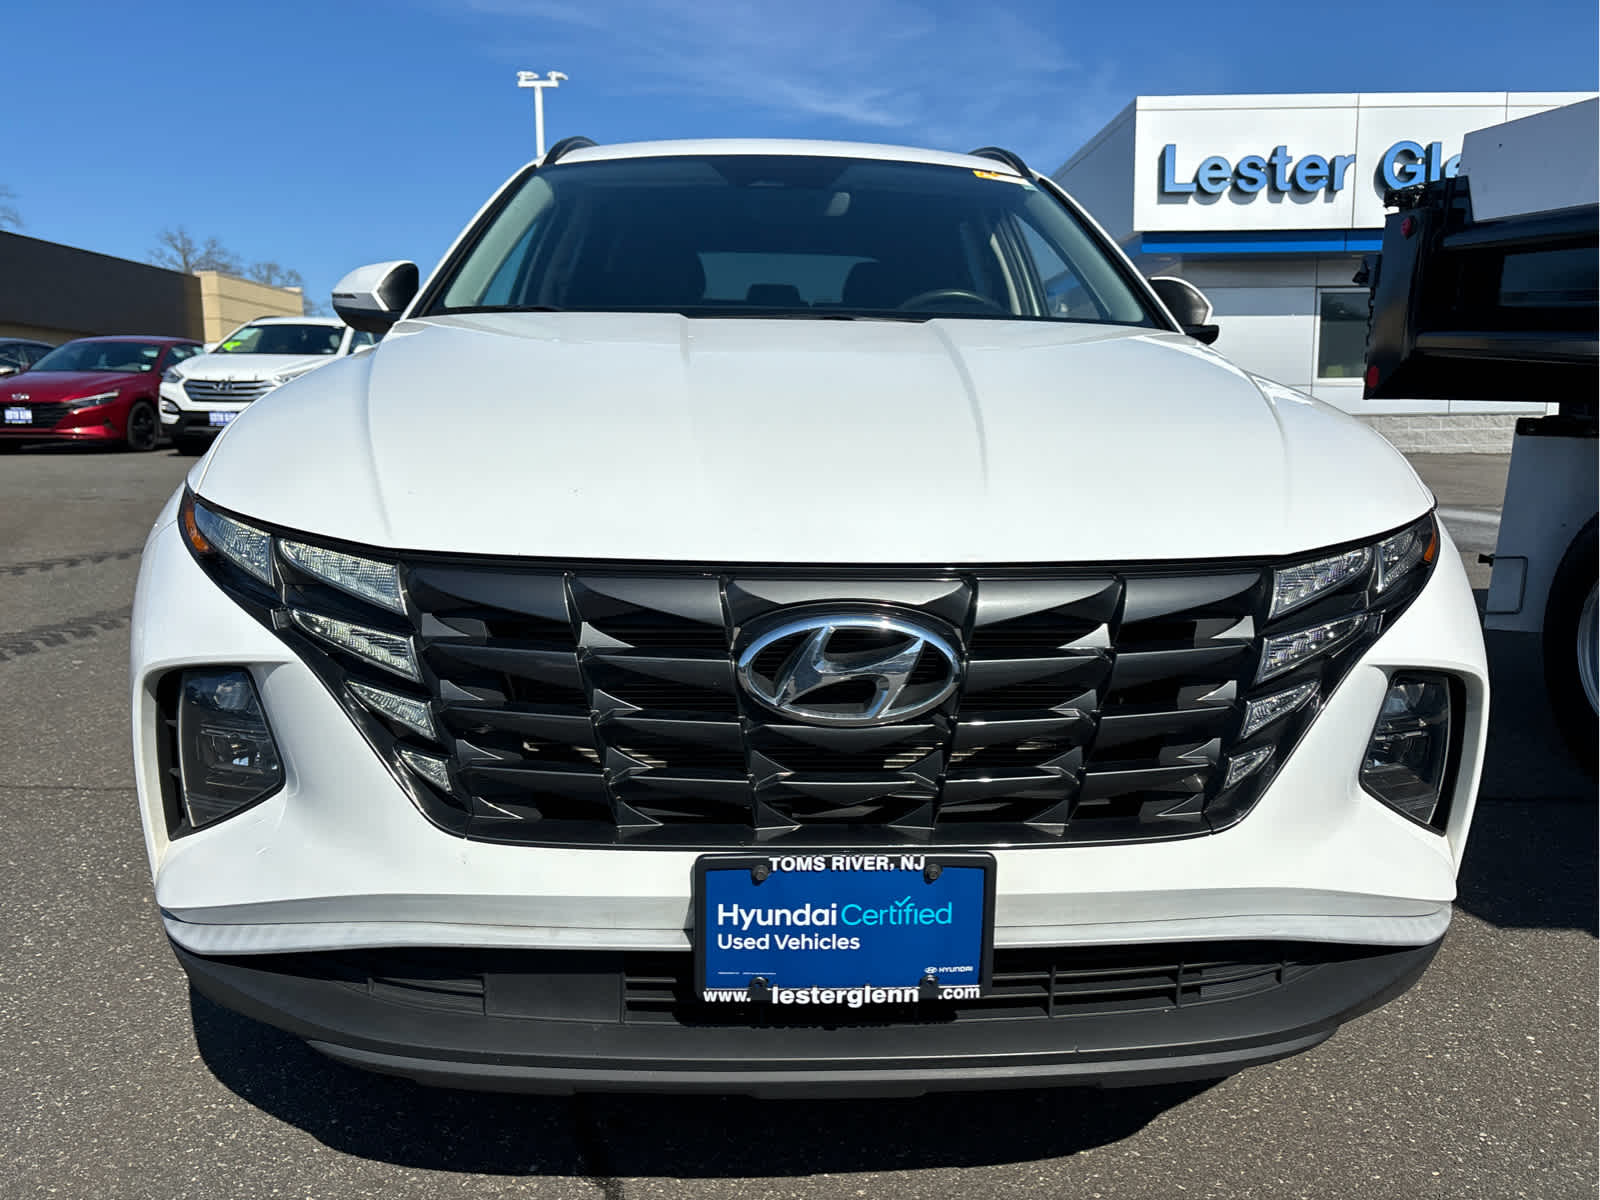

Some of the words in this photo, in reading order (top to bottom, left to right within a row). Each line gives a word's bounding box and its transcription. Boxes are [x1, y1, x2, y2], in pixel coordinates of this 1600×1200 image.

[1163, 143, 1356, 194] Lester
[768, 856, 826, 872] TOMS
[831, 856, 895, 872] RIVER,
[901, 855, 925, 871] NJ
[717, 903, 837, 931] Hyundai
[841, 896, 953, 925] Certified
[717, 933, 770, 950] Used
[774, 933, 861, 950] Vehicles
[938, 965, 974, 973] HYUNDAI
[703, 990, 751, 1002] www.
[772, 985, 919, 1008] lesterglenn
